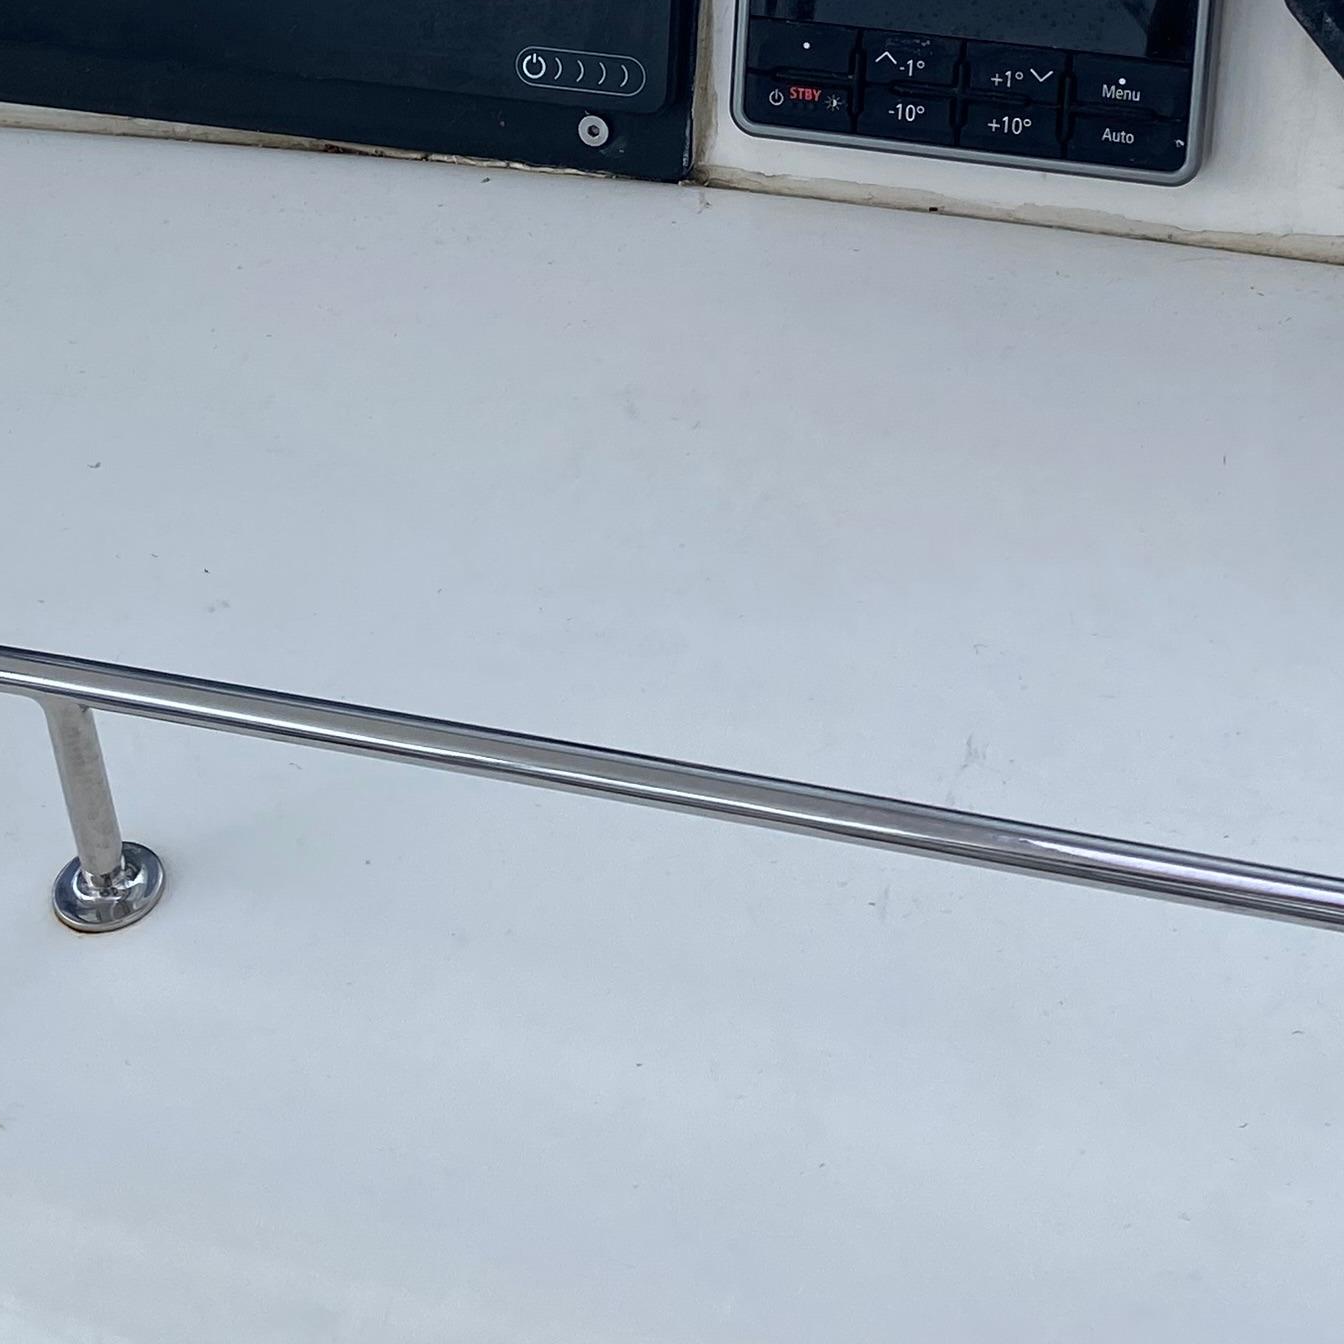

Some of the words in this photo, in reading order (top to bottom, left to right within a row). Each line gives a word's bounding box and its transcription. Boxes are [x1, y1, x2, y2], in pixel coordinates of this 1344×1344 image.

[899, 59, 926, 77] -1°
[990, 70, 1024, 89] +1°
[789, 86, 823, 102] STBY
[1101, 84, 1141, 103] Menu
[888, 103, 926, 122] -10°
[987, 116, 1032, 135] +10°
[1101, 127, 1136, 144] Auto
